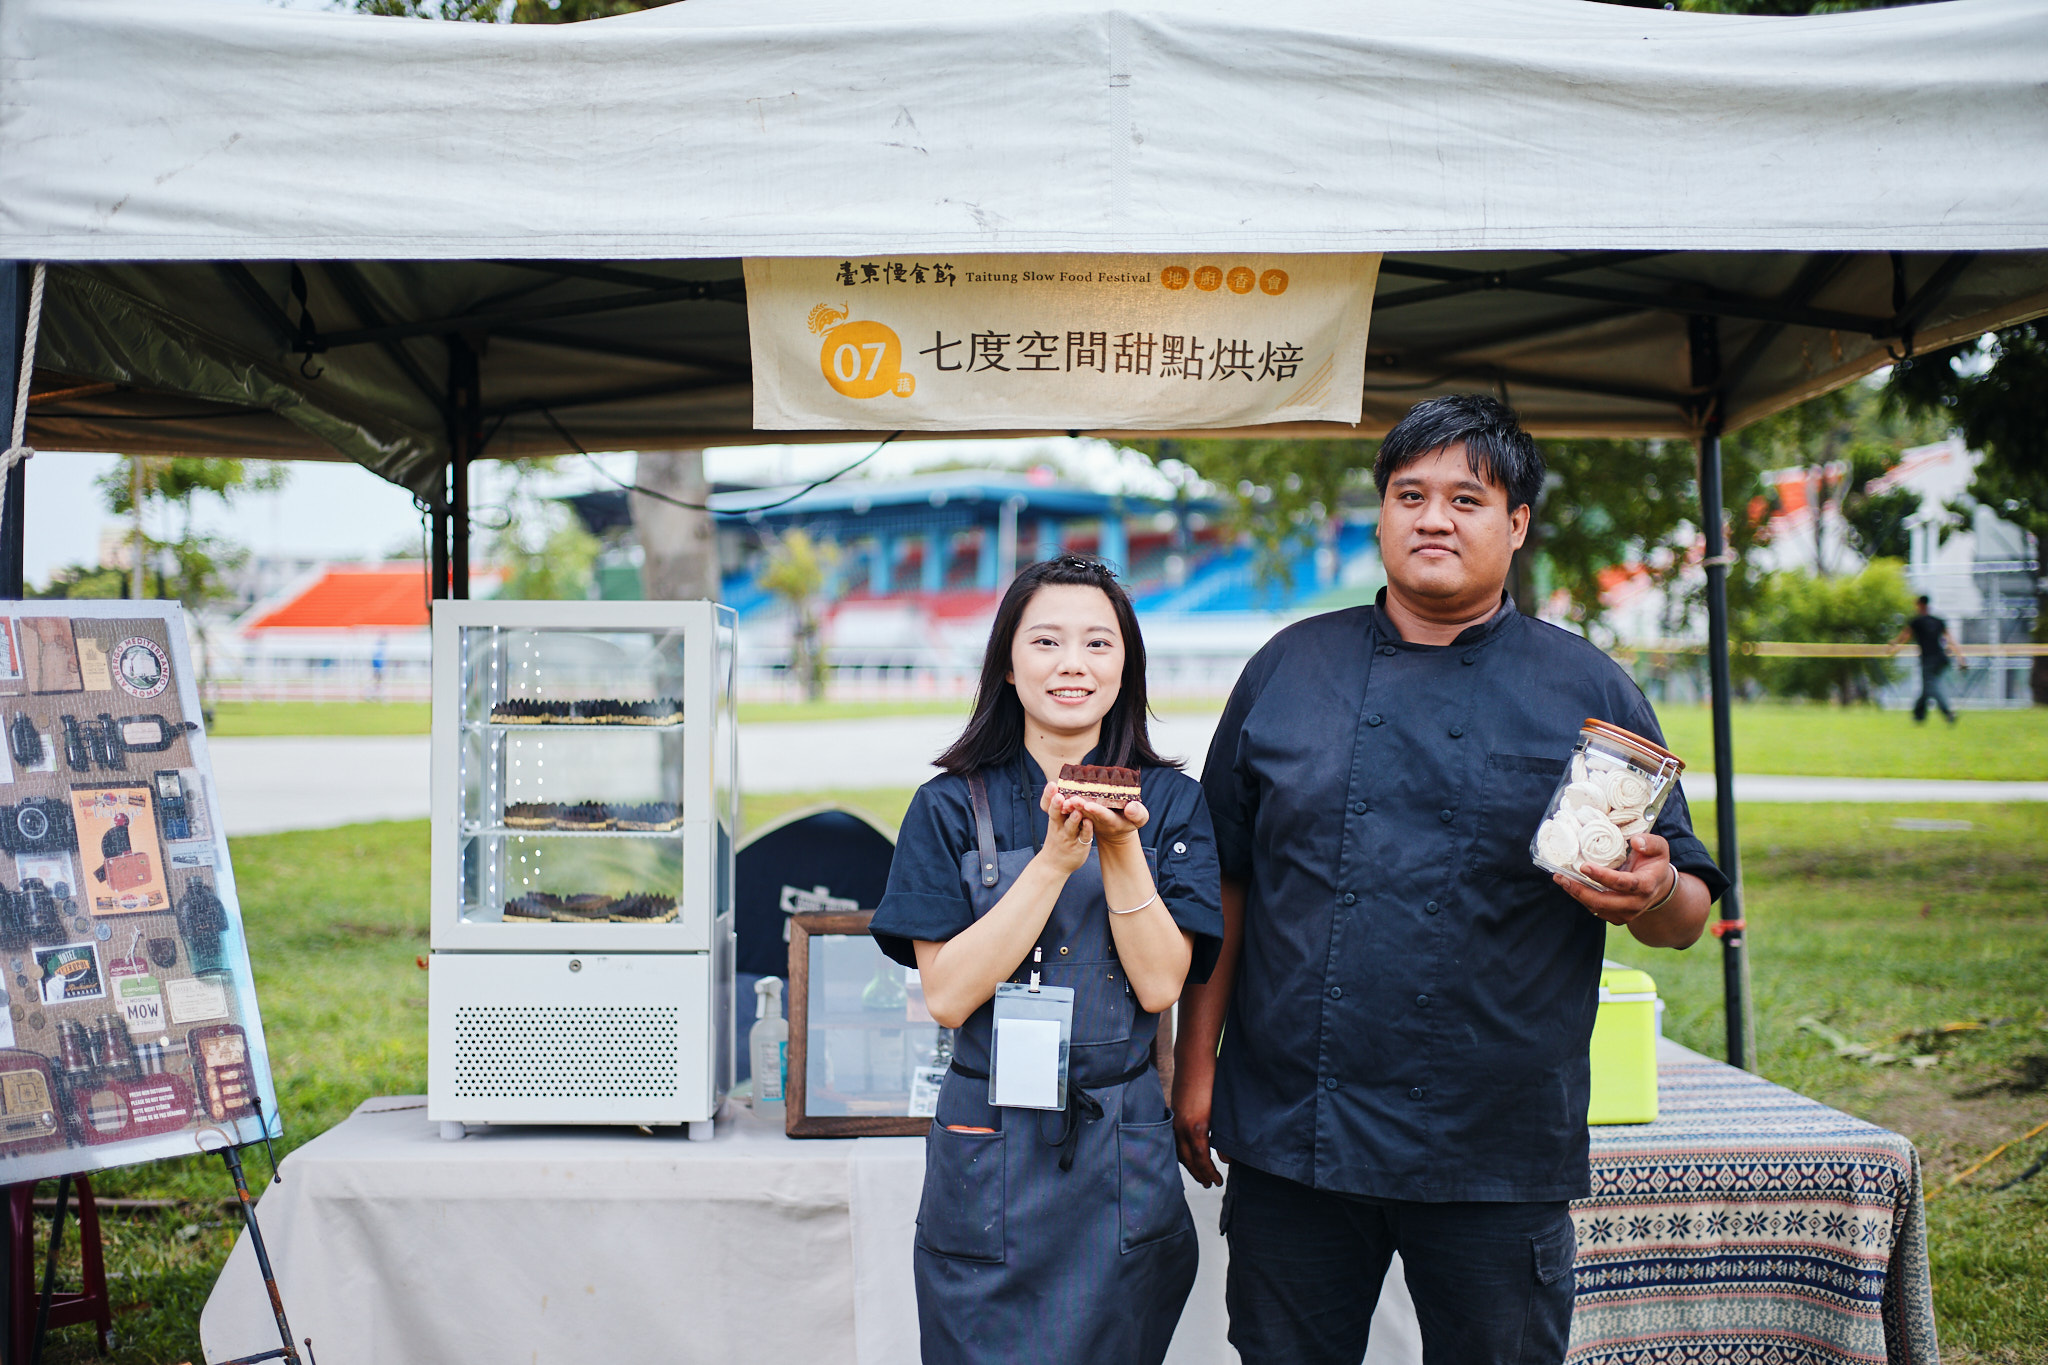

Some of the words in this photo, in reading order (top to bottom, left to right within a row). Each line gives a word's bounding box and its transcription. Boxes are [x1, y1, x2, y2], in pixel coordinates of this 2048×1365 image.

[836, 260, 957, 287] 臺東慢食節
[966, 272, 1018, 283] Taitung
[1023, 271, 1055, 281] Slow
[1060, 272, 1093, 283] Food
[1098, 272, 1151, 283] Festival
[833, 342, 887, 382] 07
[918, 329, 1305, 382] 七度空間甜點烘焙
[112, 645, 127, 687] ALBERGO
[125, 637, 169, 686] MEDITERRANEO
[132, 688, 160, 698] ROMA
[127, 1003, 158, 1019] MOW
